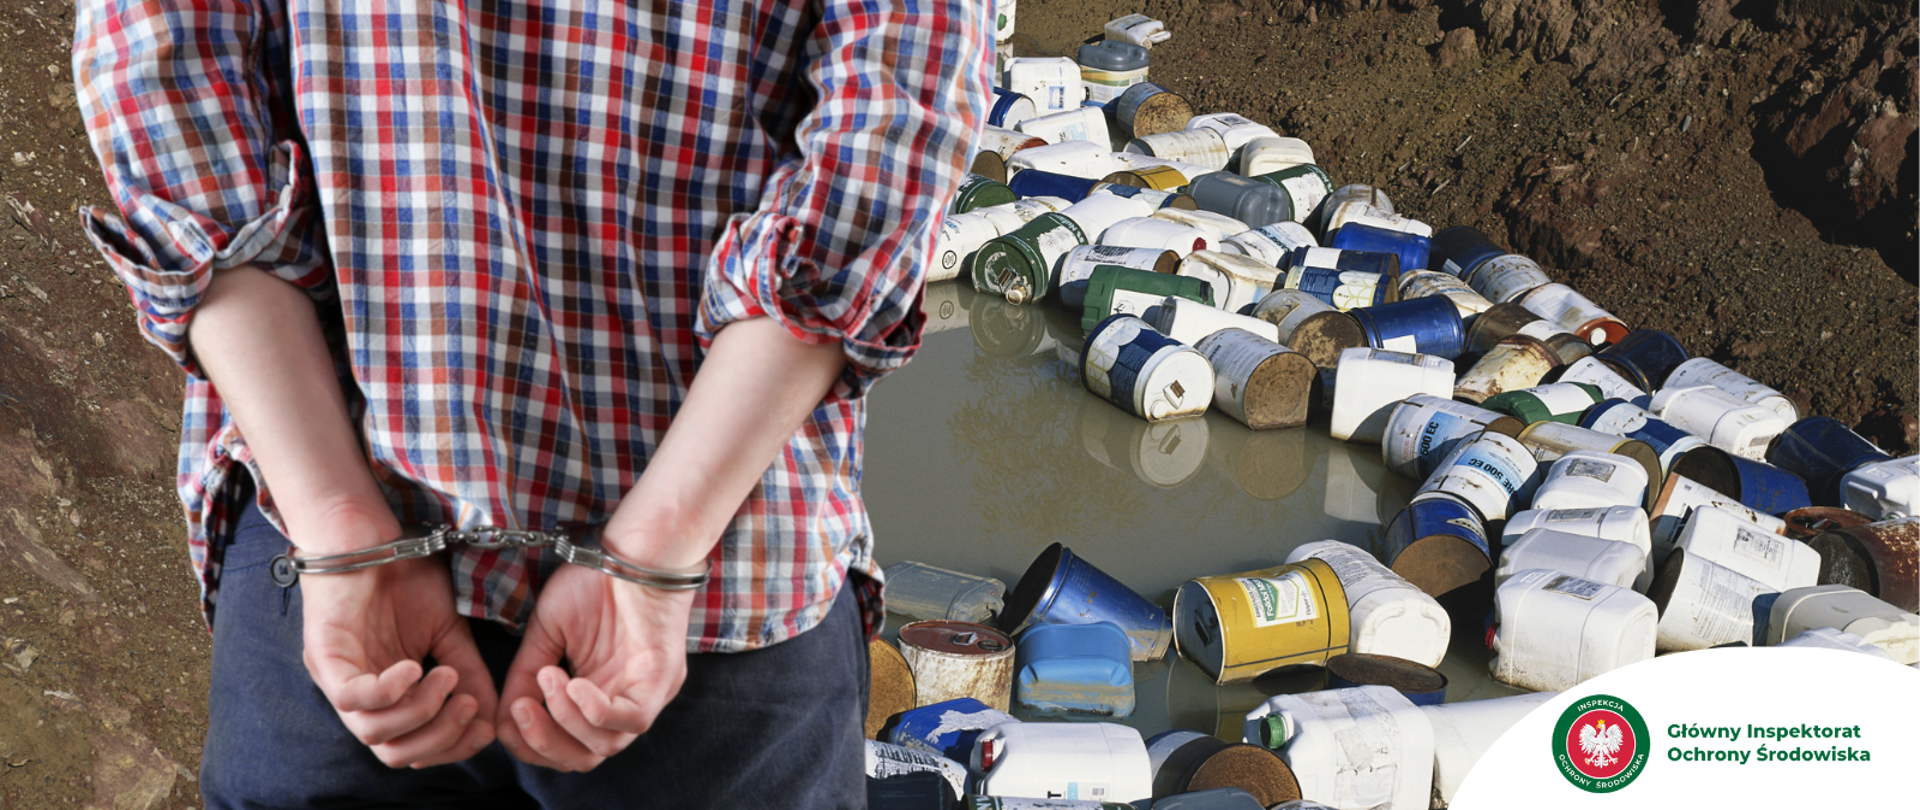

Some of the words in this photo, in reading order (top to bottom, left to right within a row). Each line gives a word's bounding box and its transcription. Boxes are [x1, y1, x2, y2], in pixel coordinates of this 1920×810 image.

[1425, 421, 1439, 435] EC
[1420, 435, 1432, 456] 500
[1468, 458, 1485, 469] EC
[1483, 463, 1504, 481] 500
[1261, 591, 1274, 617] Folidol
